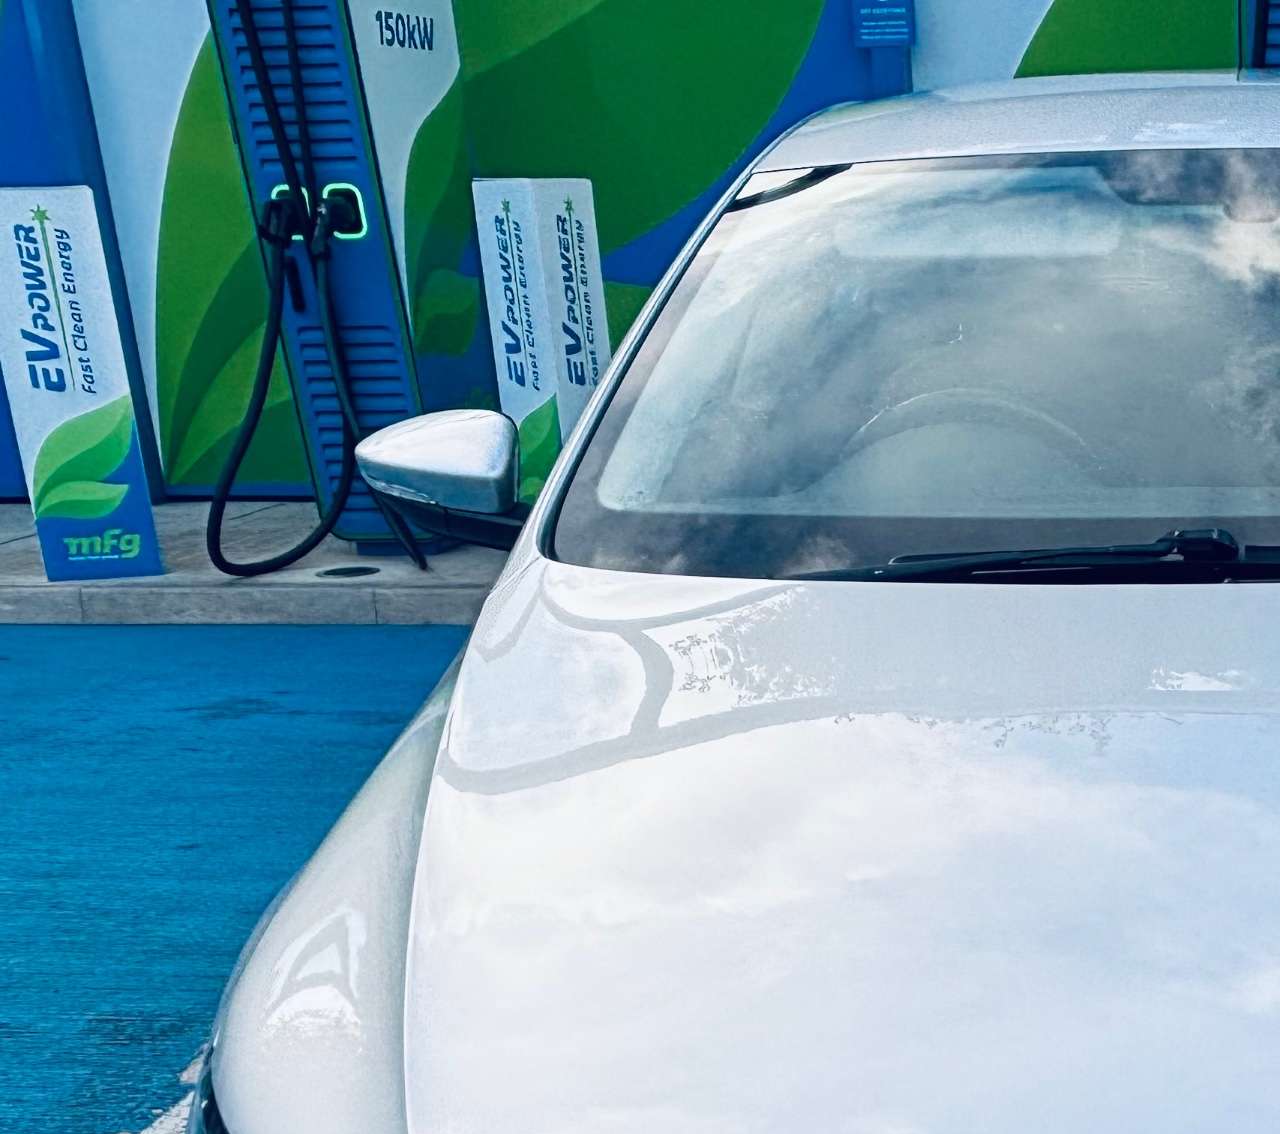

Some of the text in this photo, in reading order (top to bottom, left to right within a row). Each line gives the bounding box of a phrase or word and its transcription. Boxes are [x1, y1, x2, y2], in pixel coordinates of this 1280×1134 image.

[376, 10, 433, 51] 150kW
[54, 228, 97, 394] Fast Clean Energy
[63, 529, 140, 558] mfg
